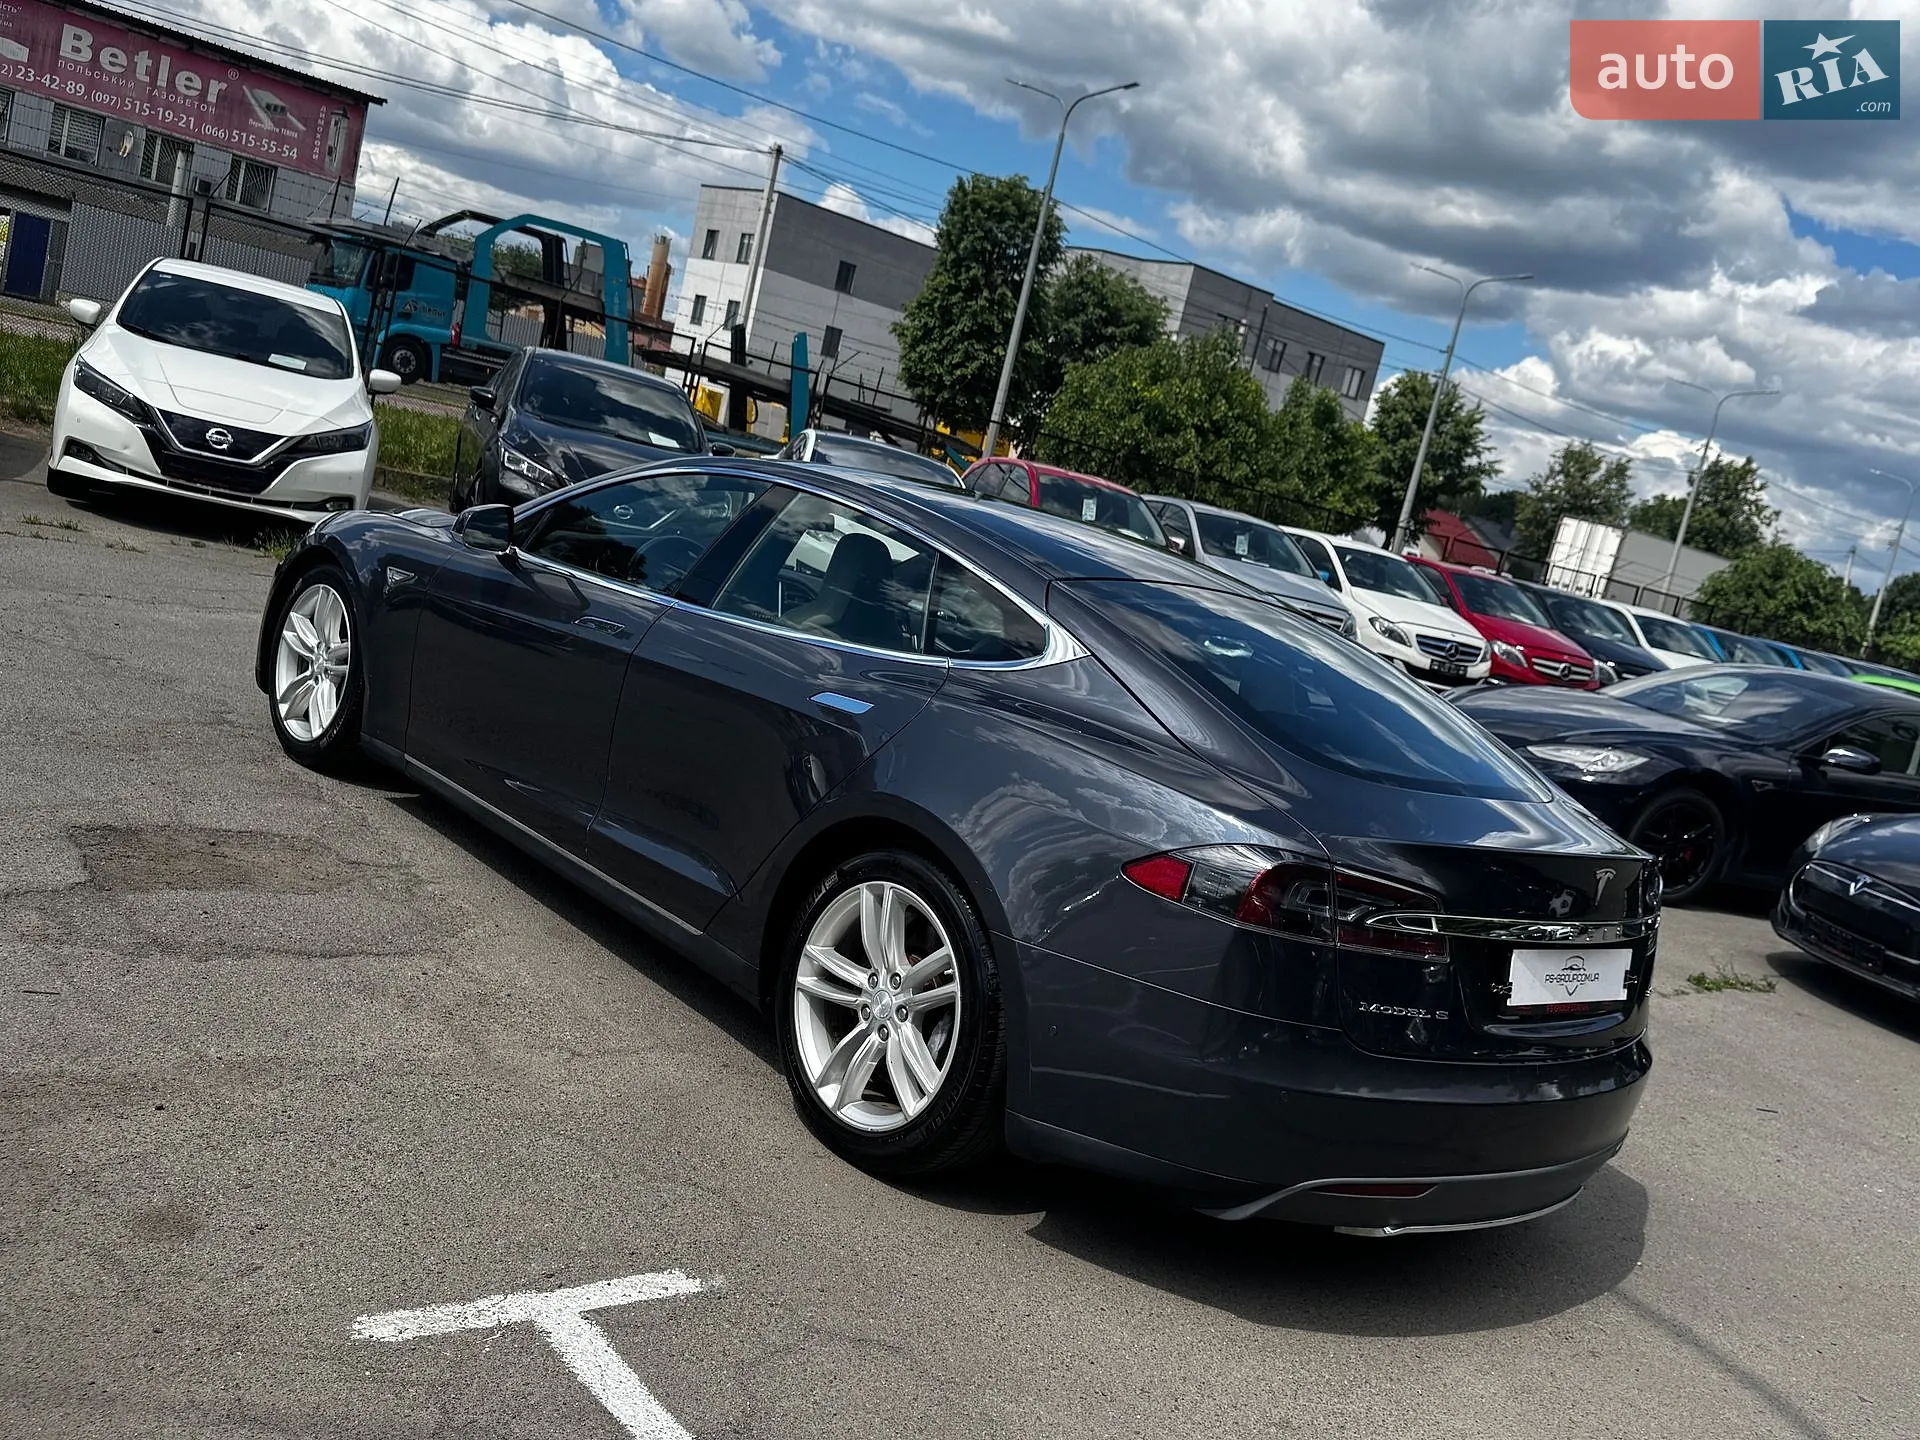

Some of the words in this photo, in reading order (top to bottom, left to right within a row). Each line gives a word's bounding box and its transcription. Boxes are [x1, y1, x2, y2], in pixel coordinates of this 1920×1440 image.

[58, 60, 136, 89] ПОЛЬСЬКИЙ
[146, 86, 216, 115] ГАЗОБЕТОН
[60, 23, 227, 103] Betler
[91, 90, 121, 109] (097)
[201, 122, 229, 140] (066)
[231, 130, 298, 160] 515-55-54
[1359, 1001, 1431, 1019] MODEL
[1436, 1011, 1448, 1019] S
